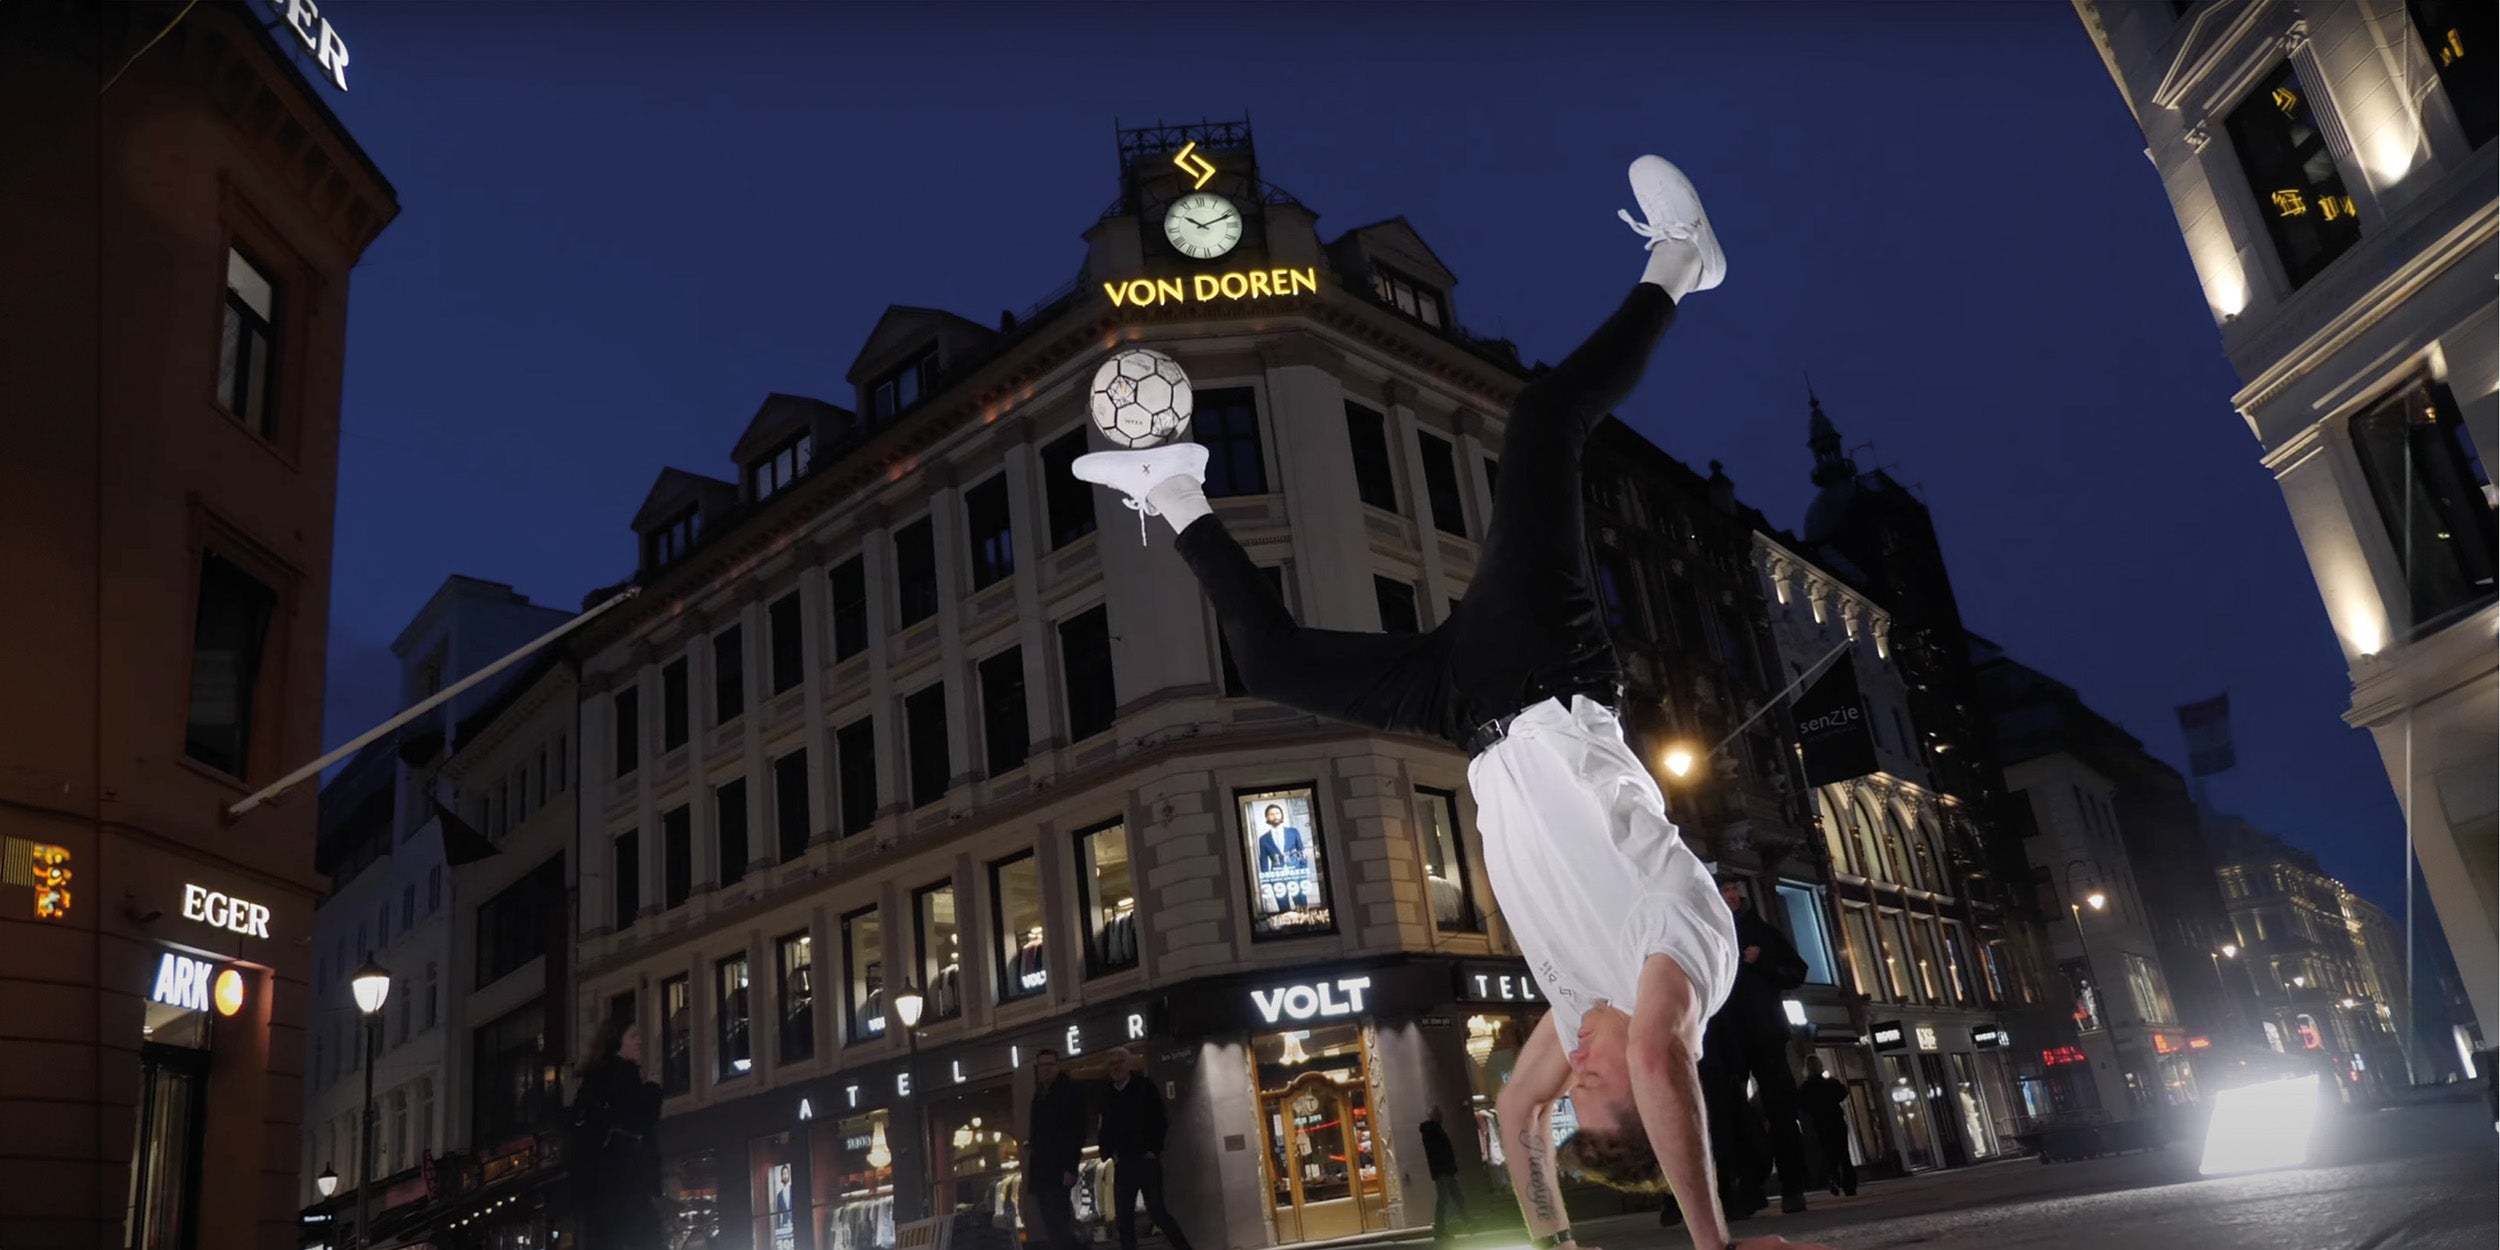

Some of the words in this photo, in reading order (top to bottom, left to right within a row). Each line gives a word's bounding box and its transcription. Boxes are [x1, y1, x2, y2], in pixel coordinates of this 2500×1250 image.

[272, 0, 350, 91] ER
[1103, 277, 1184, 307] VON
[1194, 267, 1317, 303] DOREN
[183, 883, 270, 939] EGER
[1261, 879, 1312, 899] 3999
[153, 952, 213, 1012] ARK
[1250, 976, 1371, 1023] VOLT
